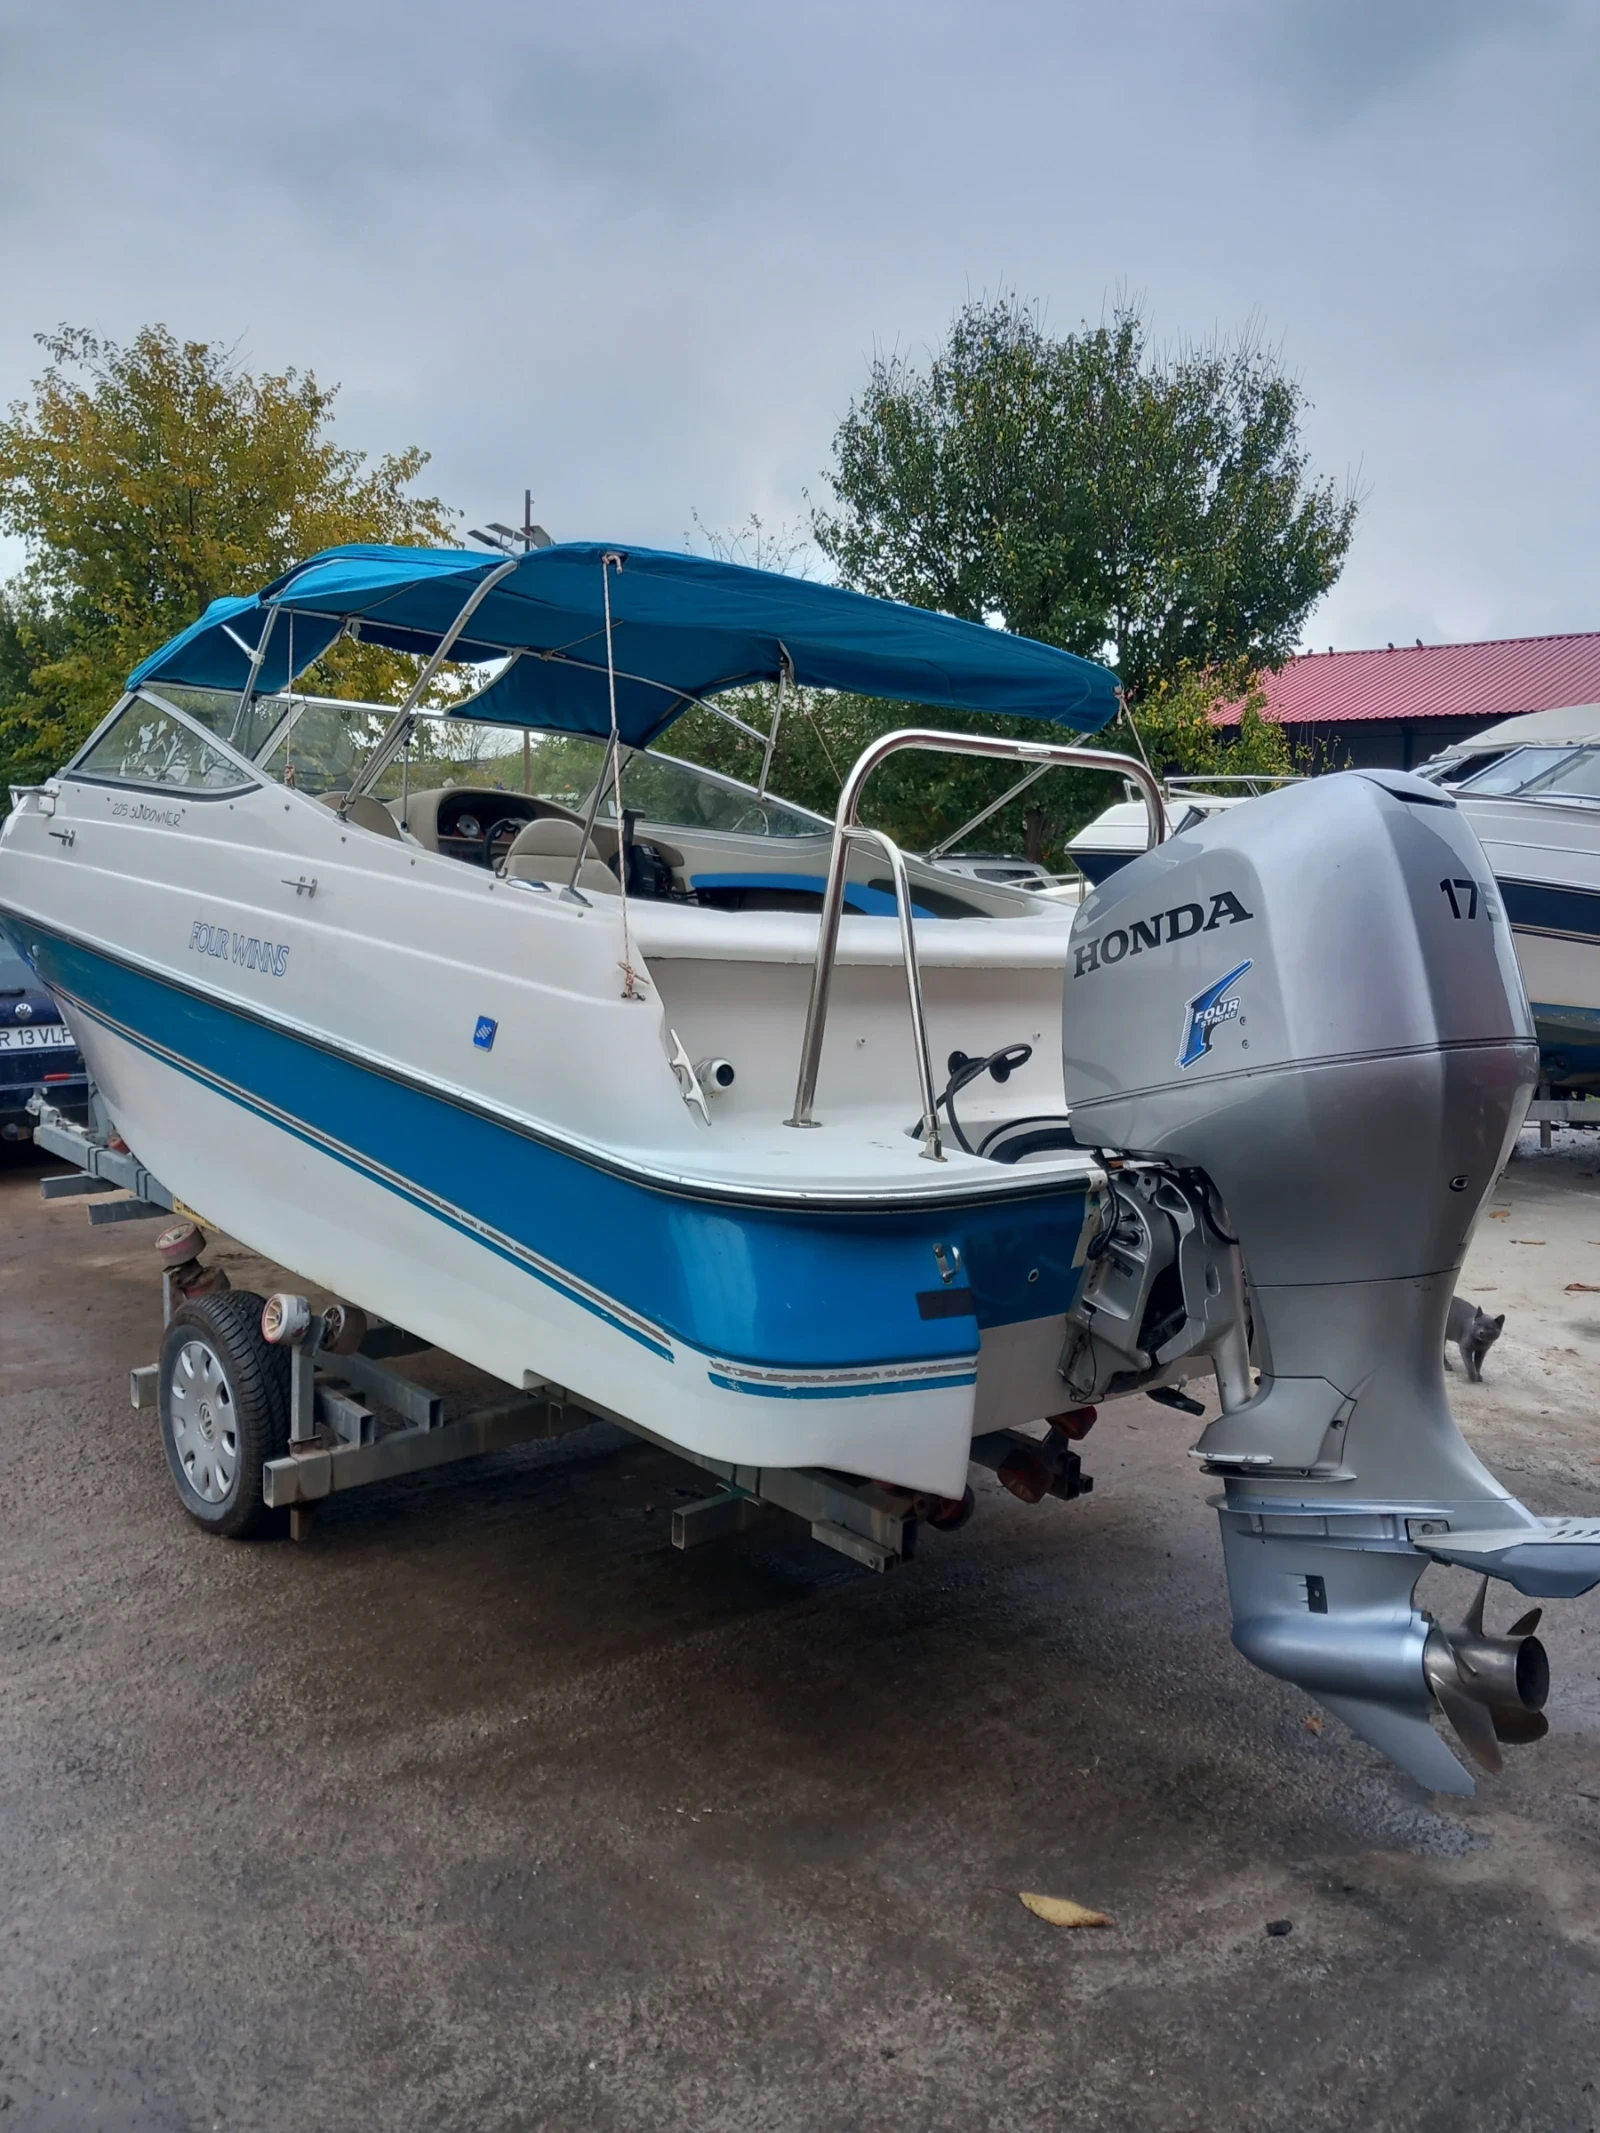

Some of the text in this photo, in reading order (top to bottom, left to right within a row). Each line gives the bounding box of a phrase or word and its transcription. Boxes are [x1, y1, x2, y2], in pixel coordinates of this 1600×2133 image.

[111, 802, 181, 828] 205 SUNDOWNER
[1073, 890, 1254, 979] HONDA
[188, 920, 291, 977] FOUR WINNS
[1194, 999, 1240, 1024] FOUR
[1200, 1010, 1238, 1028] STROKE
[17, 1029, 35, 1046] 13
